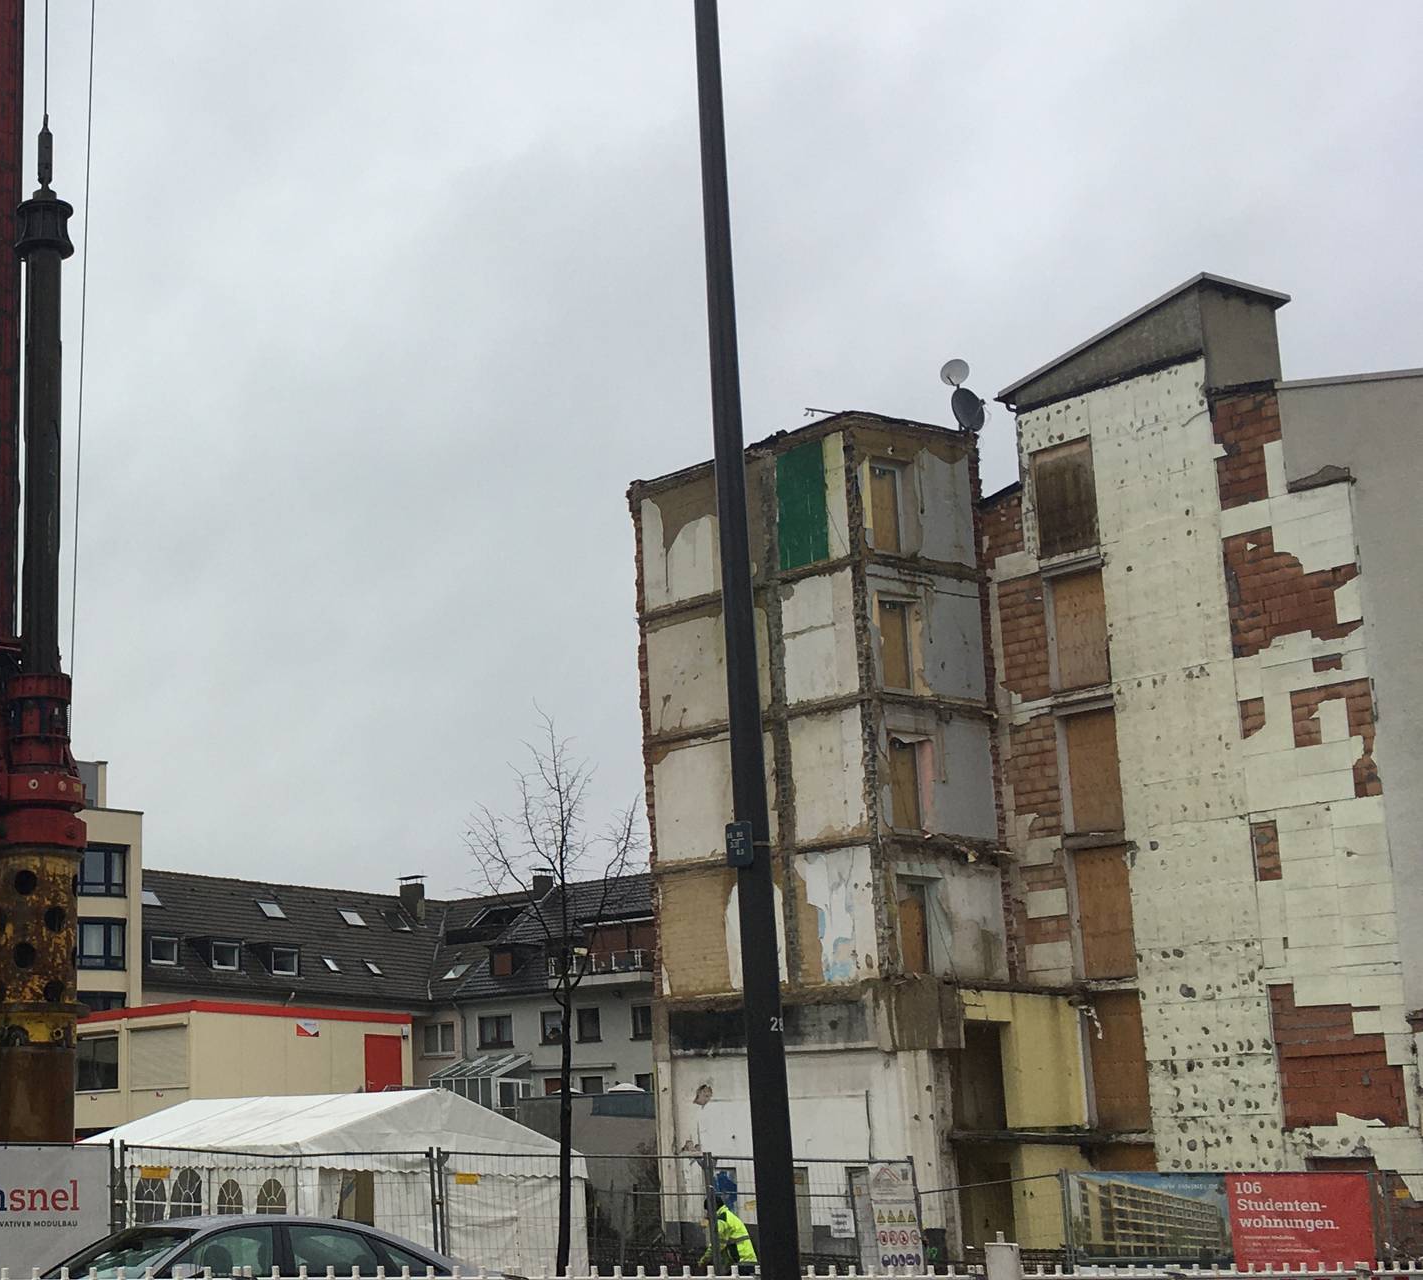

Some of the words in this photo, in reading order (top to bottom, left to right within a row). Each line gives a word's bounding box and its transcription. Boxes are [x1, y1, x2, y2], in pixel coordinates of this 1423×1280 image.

[1235, 1181, 1262, 1194] 106
[1237, 1198, 1327, 1212] Studenten-
[33, 1220, 79, 1228] MODULBAU
[1238, 1214, 1340, 1233] wohnungen.
